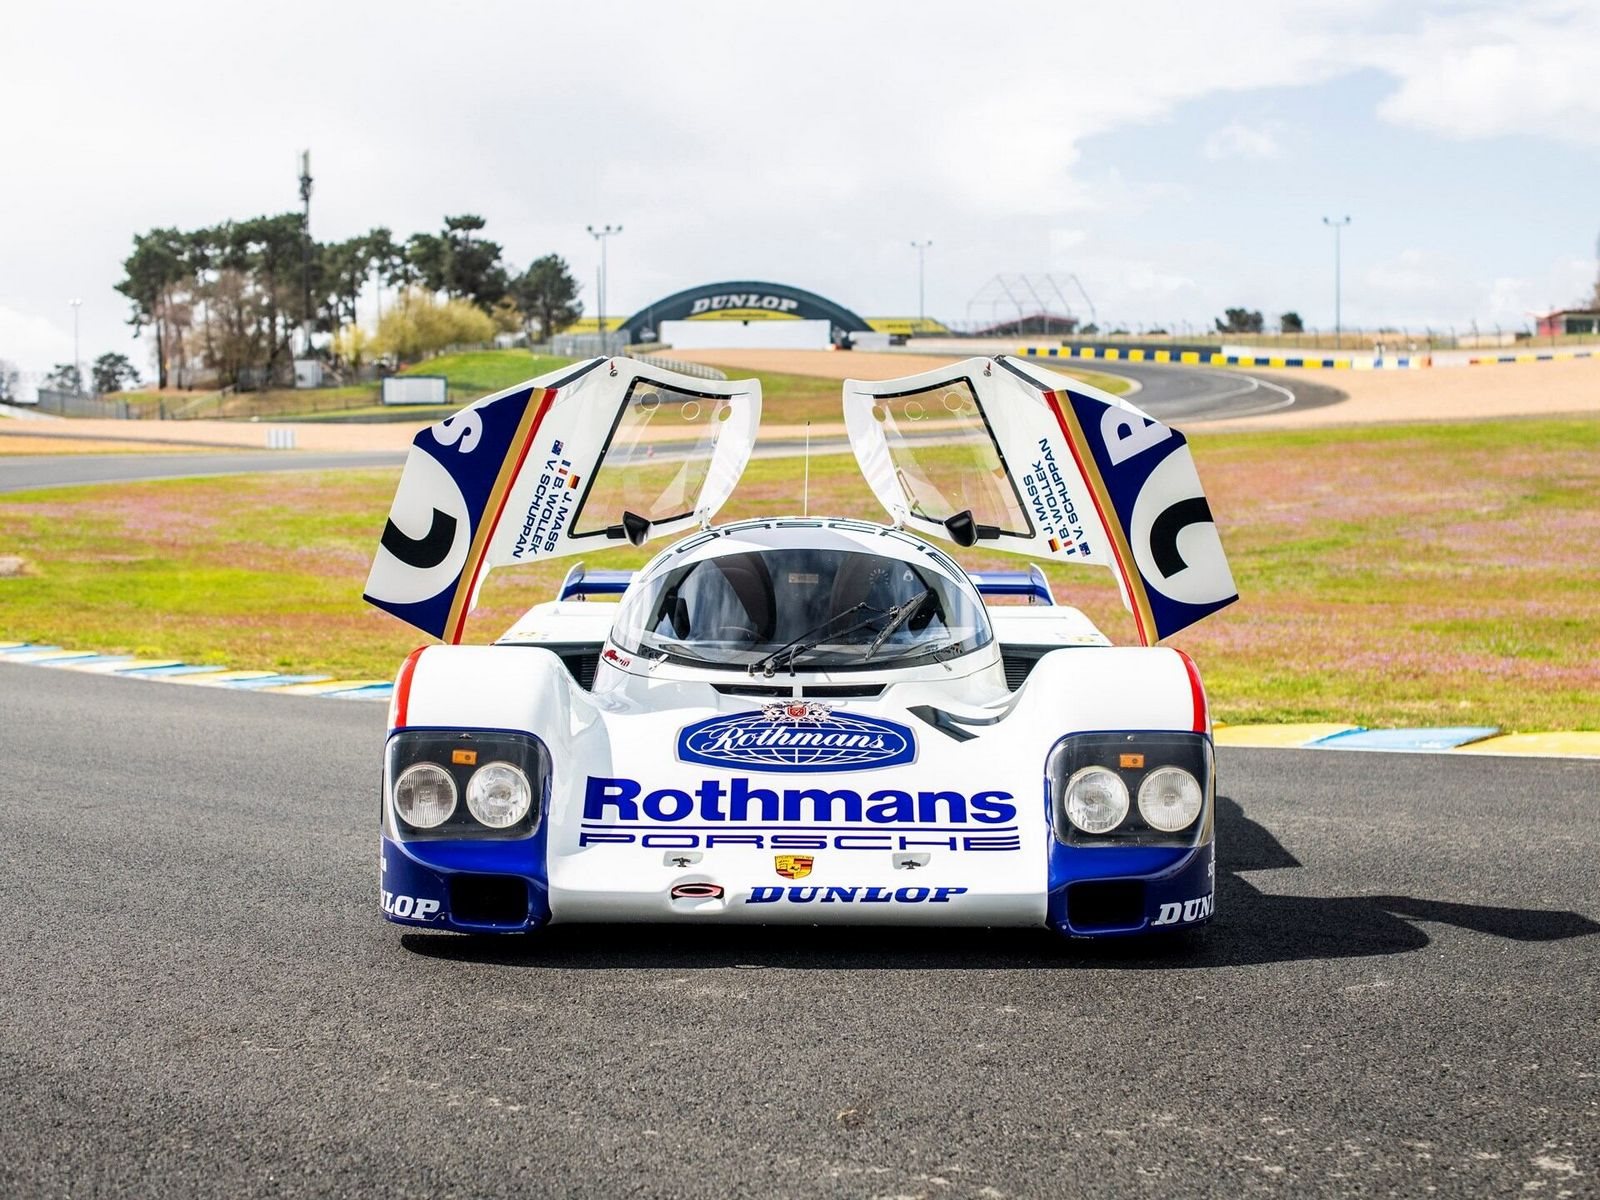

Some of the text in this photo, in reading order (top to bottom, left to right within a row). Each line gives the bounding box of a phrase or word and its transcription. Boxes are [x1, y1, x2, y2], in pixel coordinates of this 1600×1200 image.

[691, 294, 798, 314] DUNLOP
[512, 460, 557, 558] V. SCHUPPAN
[528, 476, 565, 555] B. WOLLEK
[1023, 474, 1054, 535] J. MASS
[1032, 460, 1070, 539] B. WOLLEK
[1038, 438, 1084, 540] V. SCHUPPAN
[544, 491, 572, 552] J. MASS
[700, 725, 895, 752] Rothmans
[583, 776, 1017, 824] Rothmans
[579, 832, 1020, 851] PORSCHE
[745, 886, 968, 904] DUNLOP
